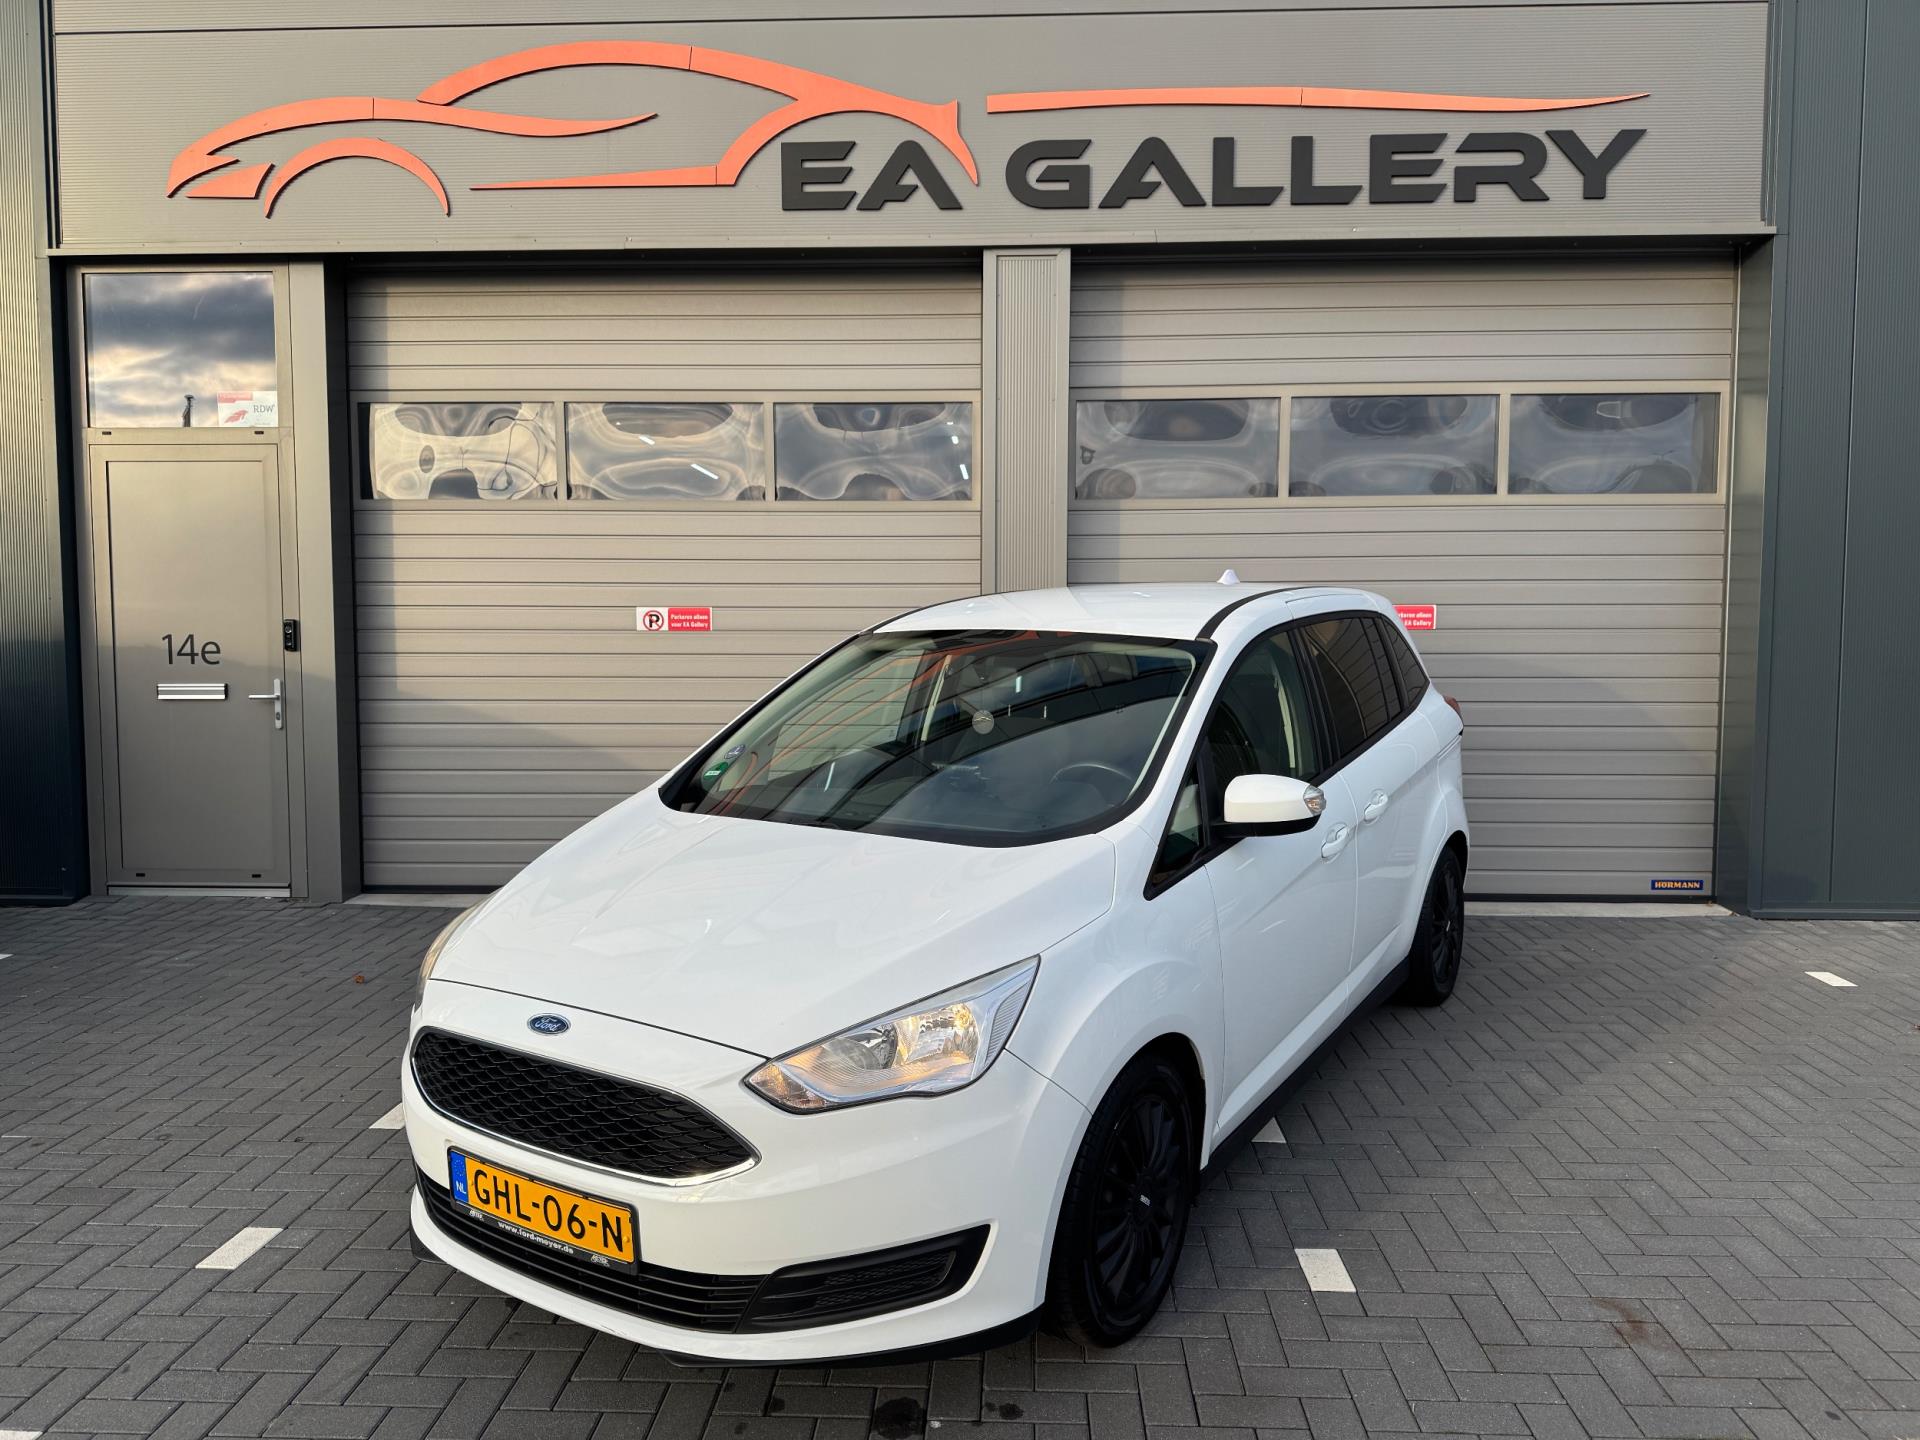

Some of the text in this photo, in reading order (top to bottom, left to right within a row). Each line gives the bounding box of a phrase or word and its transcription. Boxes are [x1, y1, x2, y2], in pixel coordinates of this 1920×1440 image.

[781, 129, 1648, 211] EA GALLERY
[253, 404, 273, 413] RDW
[162, 634, 221, 665] 14e
[456, 1181, 467, 1195] NL
[474, 1169, 624, 1252] GHL-06-N
